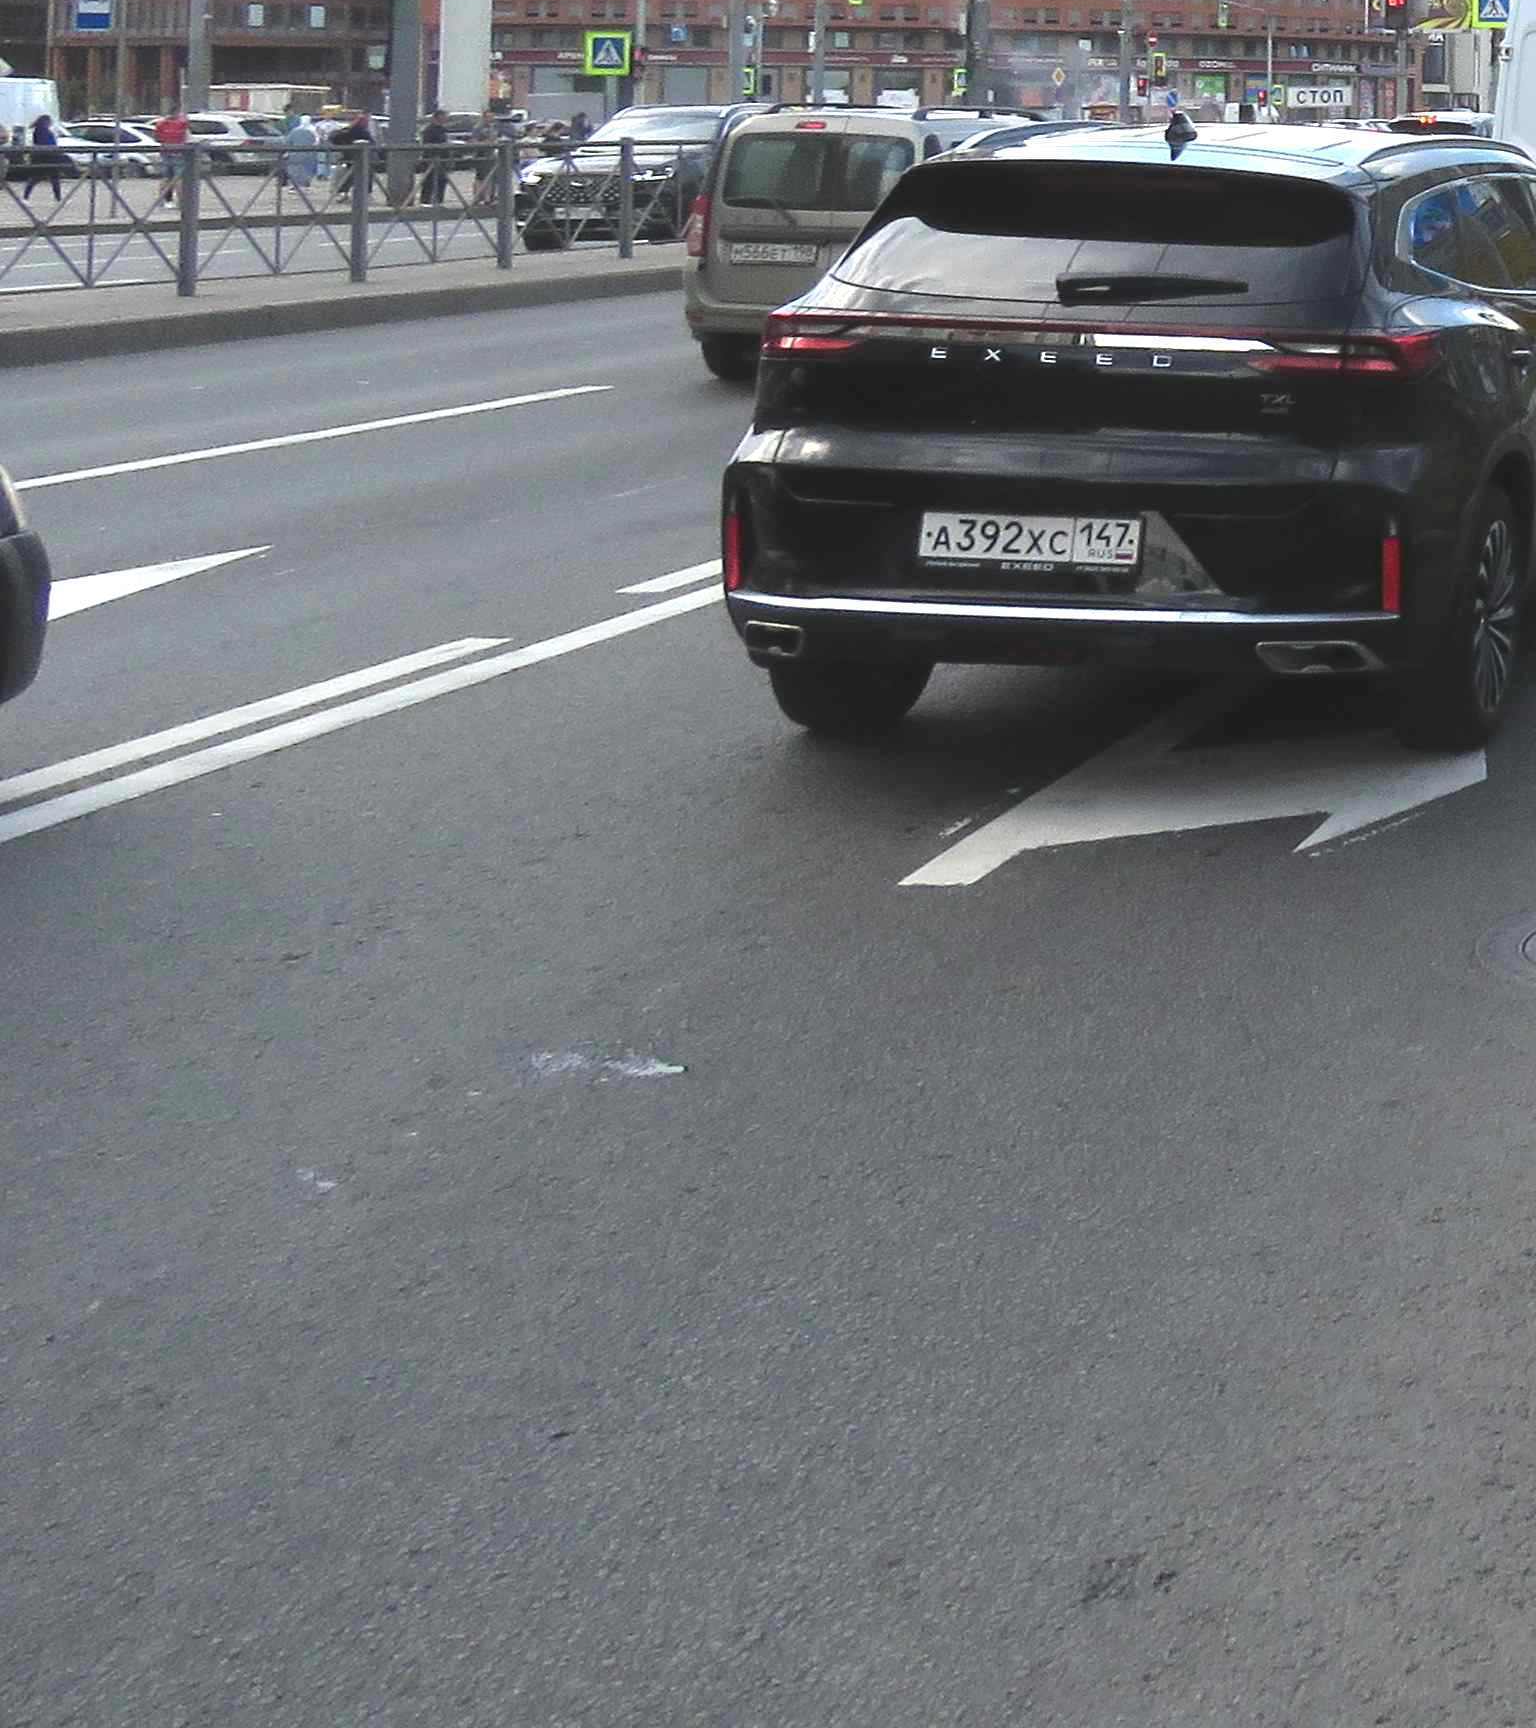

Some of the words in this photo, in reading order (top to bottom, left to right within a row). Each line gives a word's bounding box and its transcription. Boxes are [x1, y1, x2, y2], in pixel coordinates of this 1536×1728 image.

[1296, 90, 1344, 104] СТОП
[930, 346, 1173, 368] EXEED
[932, 518, 1069, 556] А392ХС
[1079, 522, 1130, 548] 147
[1088, 549, 1113, 559] RUS
[1000, 562, 1054, 572] EXEED
